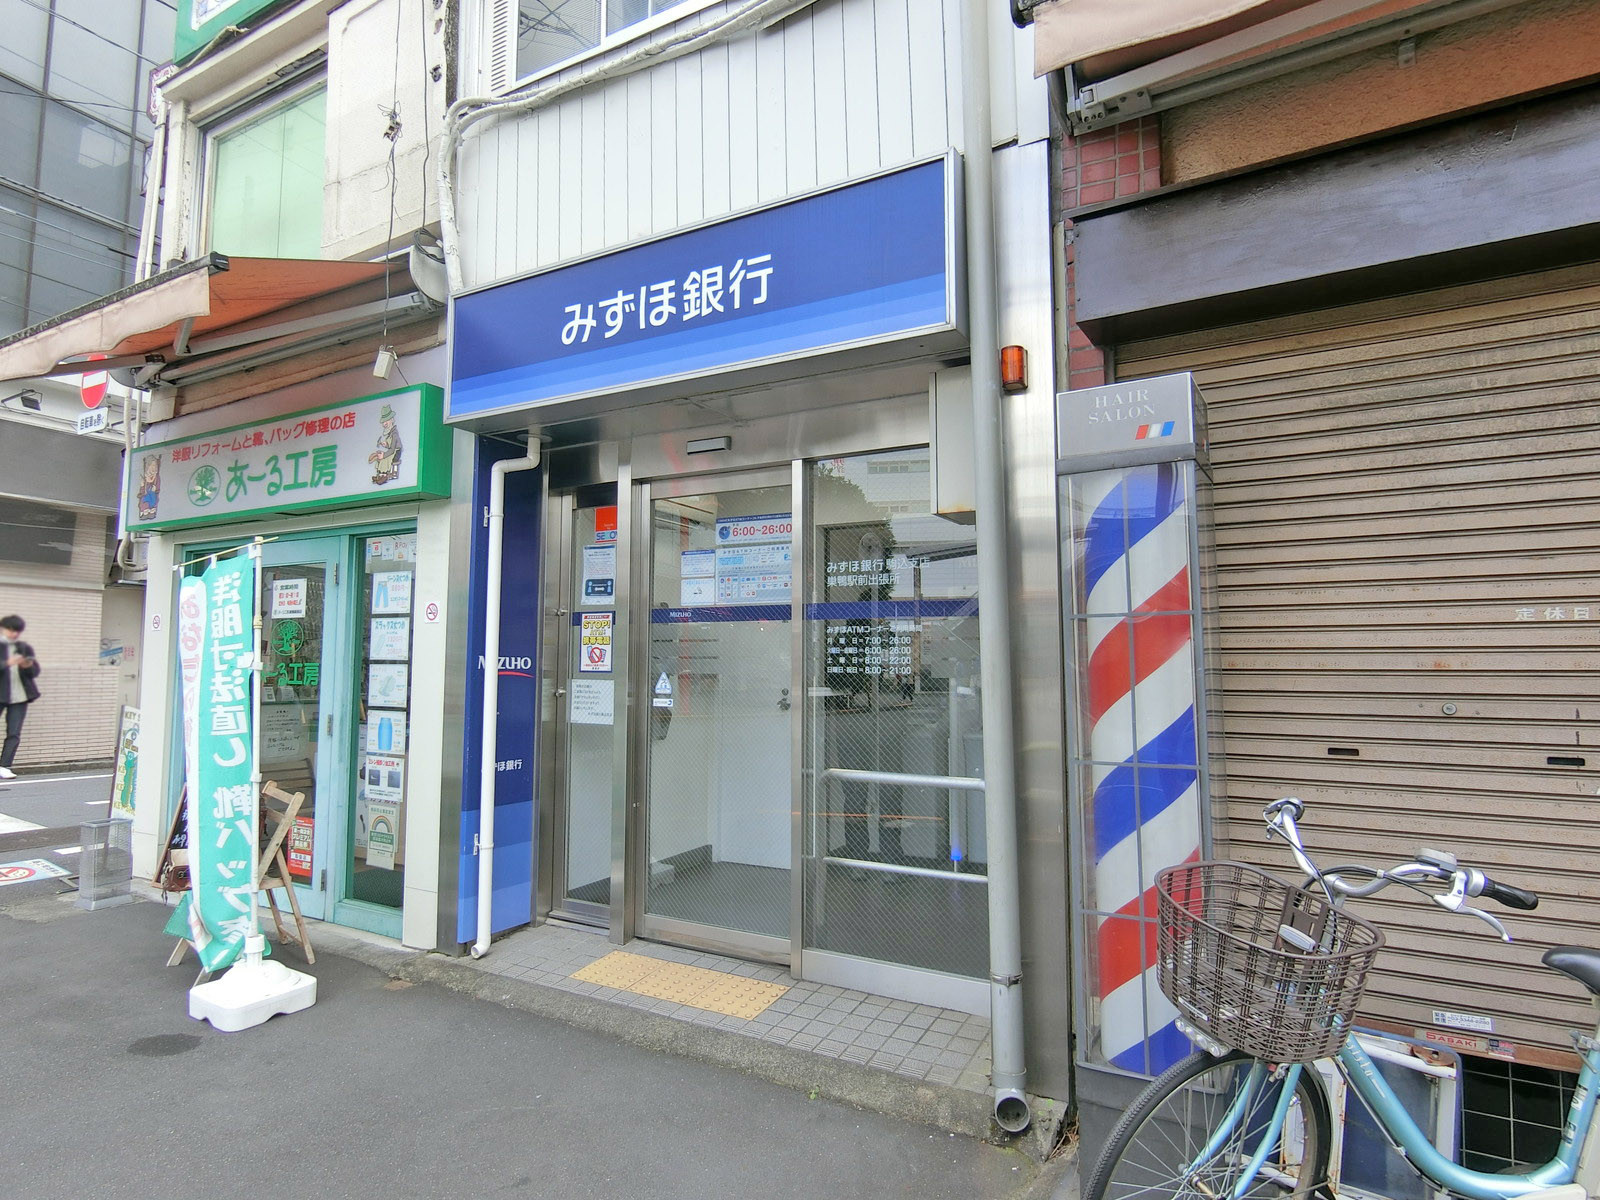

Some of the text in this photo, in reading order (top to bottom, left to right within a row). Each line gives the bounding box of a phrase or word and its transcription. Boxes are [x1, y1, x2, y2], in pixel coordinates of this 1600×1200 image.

[561, 253, 774, 345] みずほ銀行
[1095, 388, 1149, 408] HAIR
[1088, 403, 1155, 424] SALON
[226, 444, 338, 502] あーる工房
[826, 558, 883, 573] みずほ銀行
[827, 572, 901, 588] 巣鴨駅前出張所
[1515, 606, 1590, 621] 定休日
[583, 619, 610, 629] STOP!
[478, 655, 531, 670] MZUHO
[1425, 1031, 1477, 1048] SASAKI
